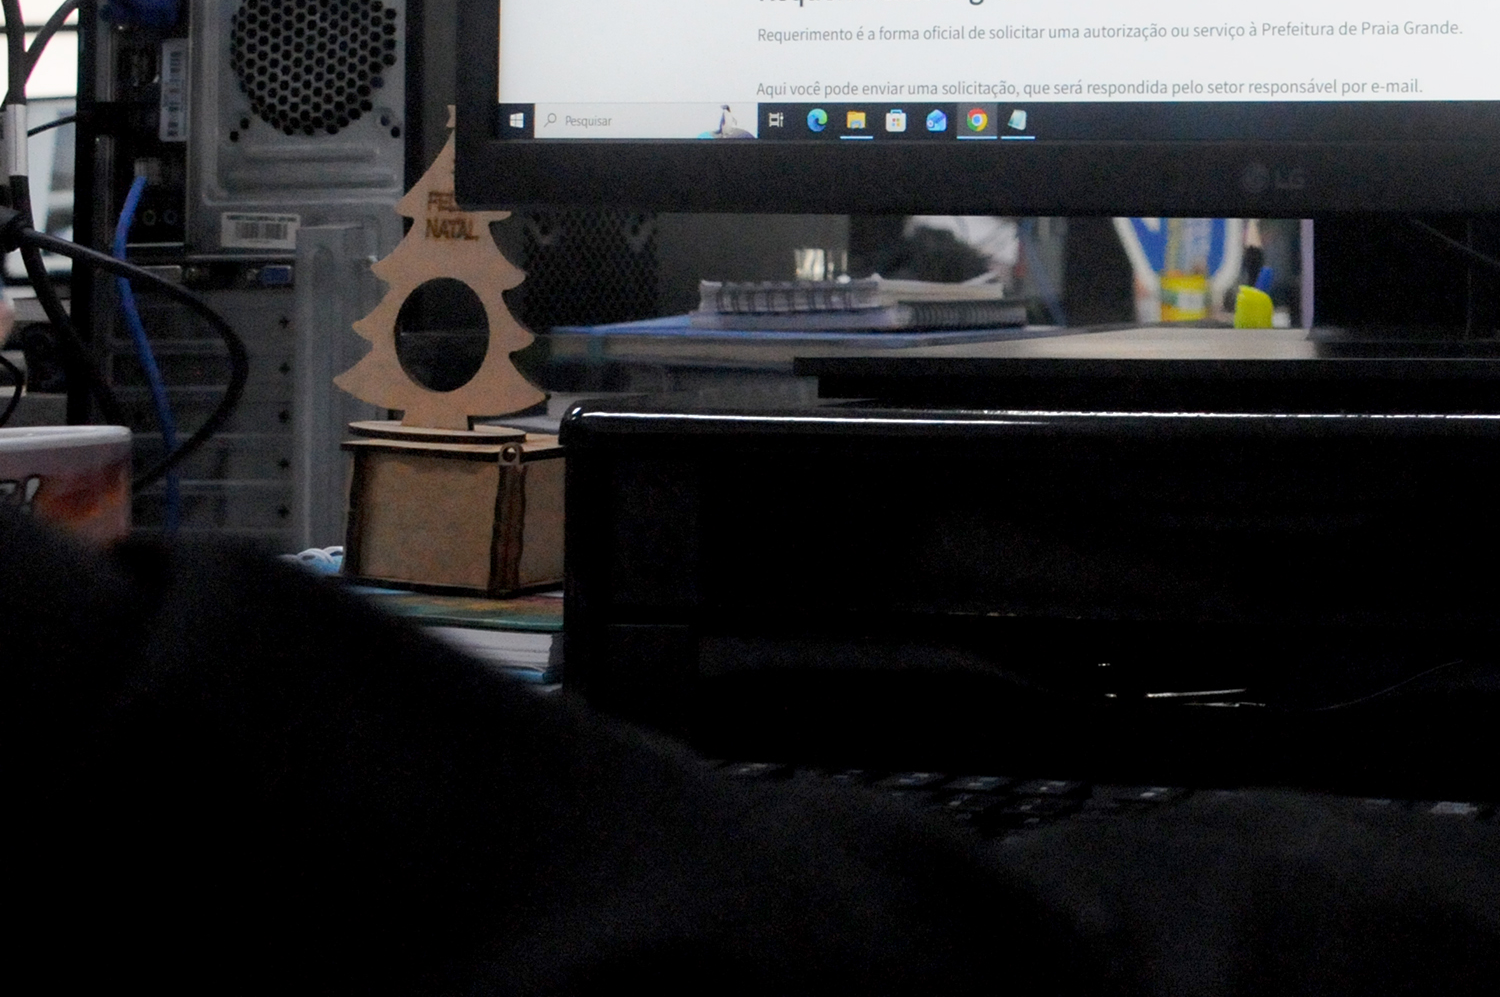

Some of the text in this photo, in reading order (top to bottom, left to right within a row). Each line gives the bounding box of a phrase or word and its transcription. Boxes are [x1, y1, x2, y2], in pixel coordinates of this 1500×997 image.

[757, 19, 1464, 44] Requerimento é a forma oficial de solicitar uma autorização ou serviço à Prefeitura de Praia Grande.
[756, 78, 1423, 99] Aqui você pode enviar uma solicitação, que será respondida pelo setor responsável por e-mail.
[565, 115, 612, 129] Pesquisar
[425, 217, 480, 241] NATAL
